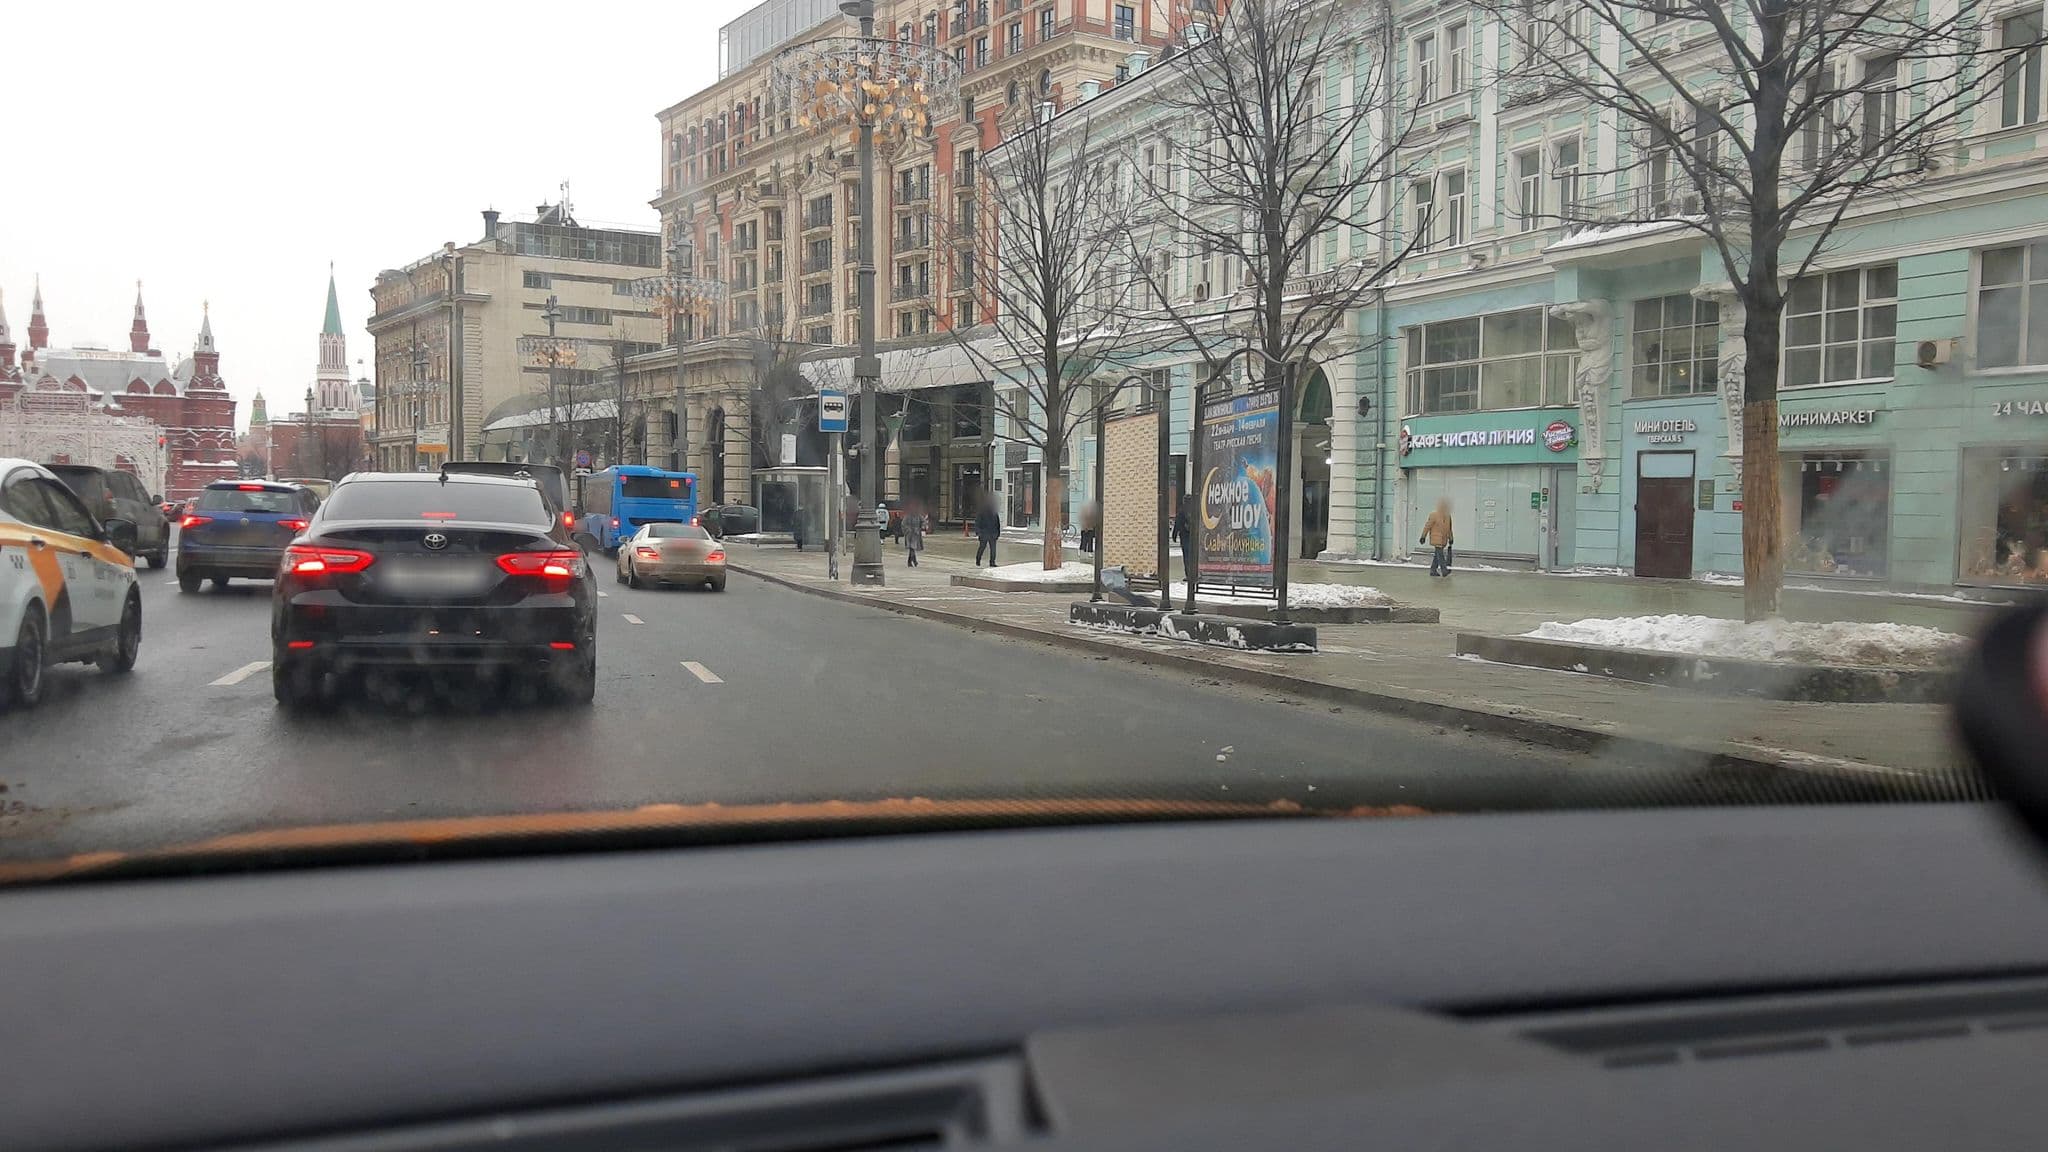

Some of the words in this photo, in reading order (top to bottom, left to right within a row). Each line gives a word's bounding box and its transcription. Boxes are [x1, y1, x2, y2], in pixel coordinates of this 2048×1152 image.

[1991, 401, 2012, 416] 24
[1634, 420, 1660, 433] МИНИ
[1661, 419, 1697, 432] ОТЕЛЬ
[1779, 409, 1876, 427] МИНИМАРКЕТ
[1411, 433, 1442, 449] КАФЕ
[1442, 430, 1486, 448] ЧИСТАЯ
[1487, 428, 1535, 446] ЛИНИЯ
[1231, 503, 1261, 529] ШОУ
